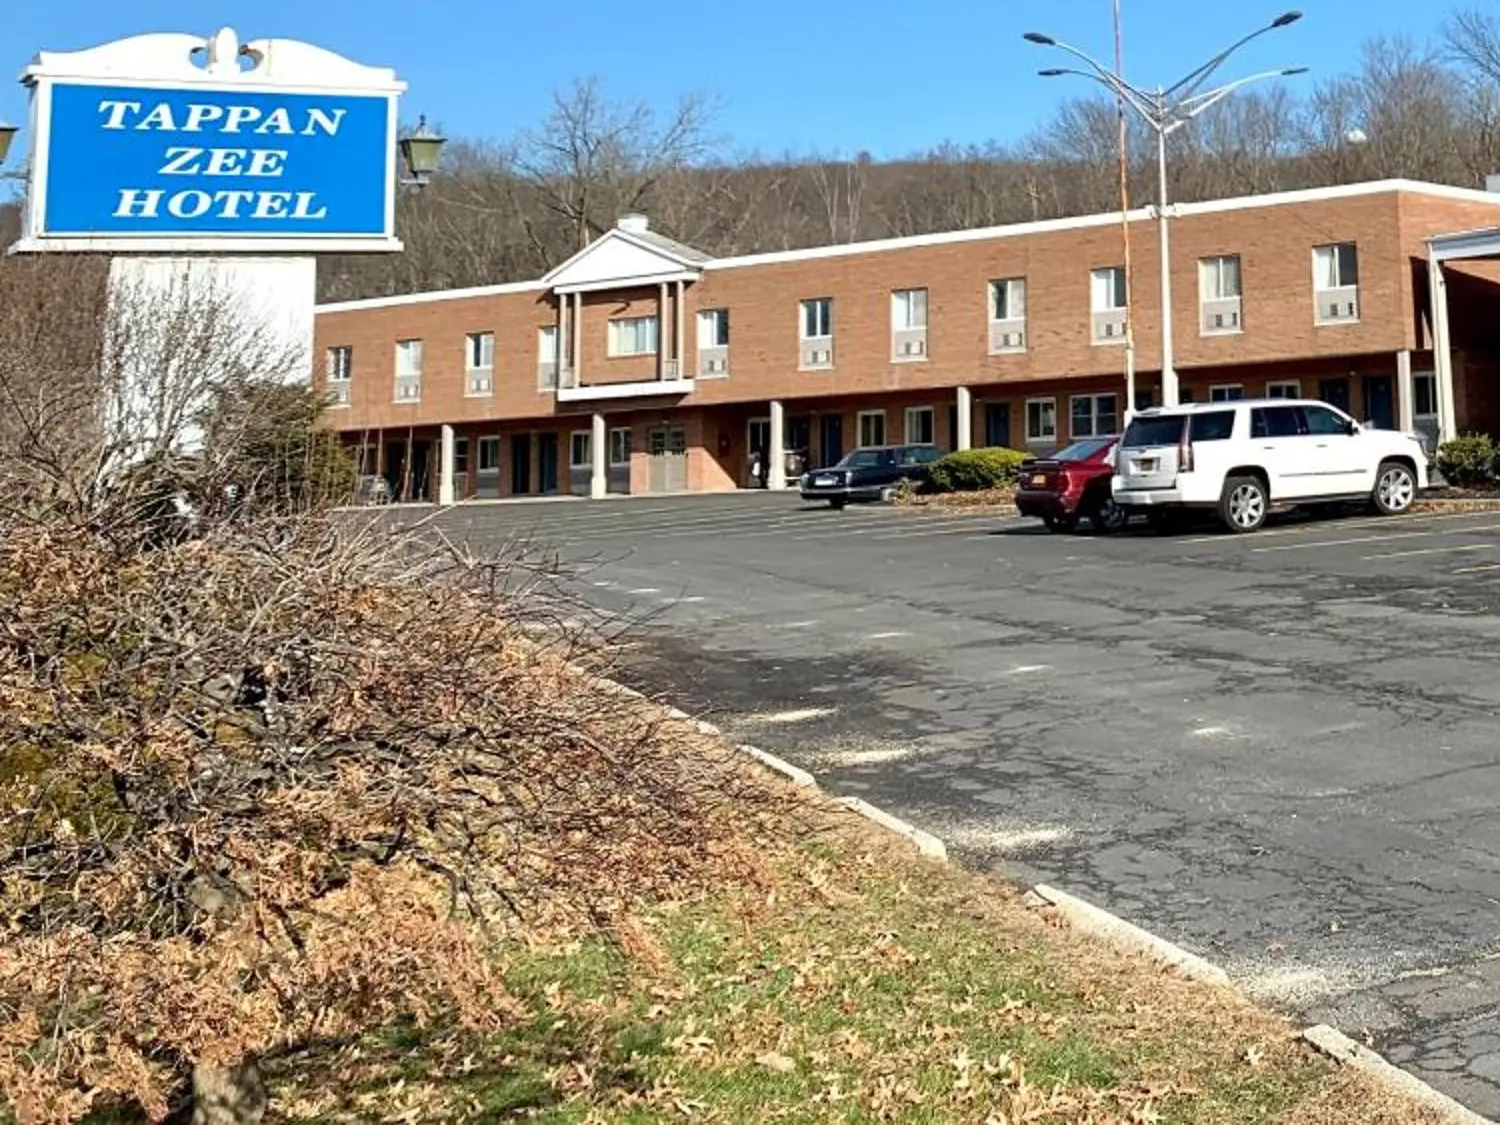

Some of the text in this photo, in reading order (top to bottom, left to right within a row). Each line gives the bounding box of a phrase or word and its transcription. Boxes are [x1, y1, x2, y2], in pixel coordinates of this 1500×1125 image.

[99, 100, 347, 136] TAPPAN
[158, 147, 289, 176] ZEE
[112, 189, 327, 219] HOTEL
